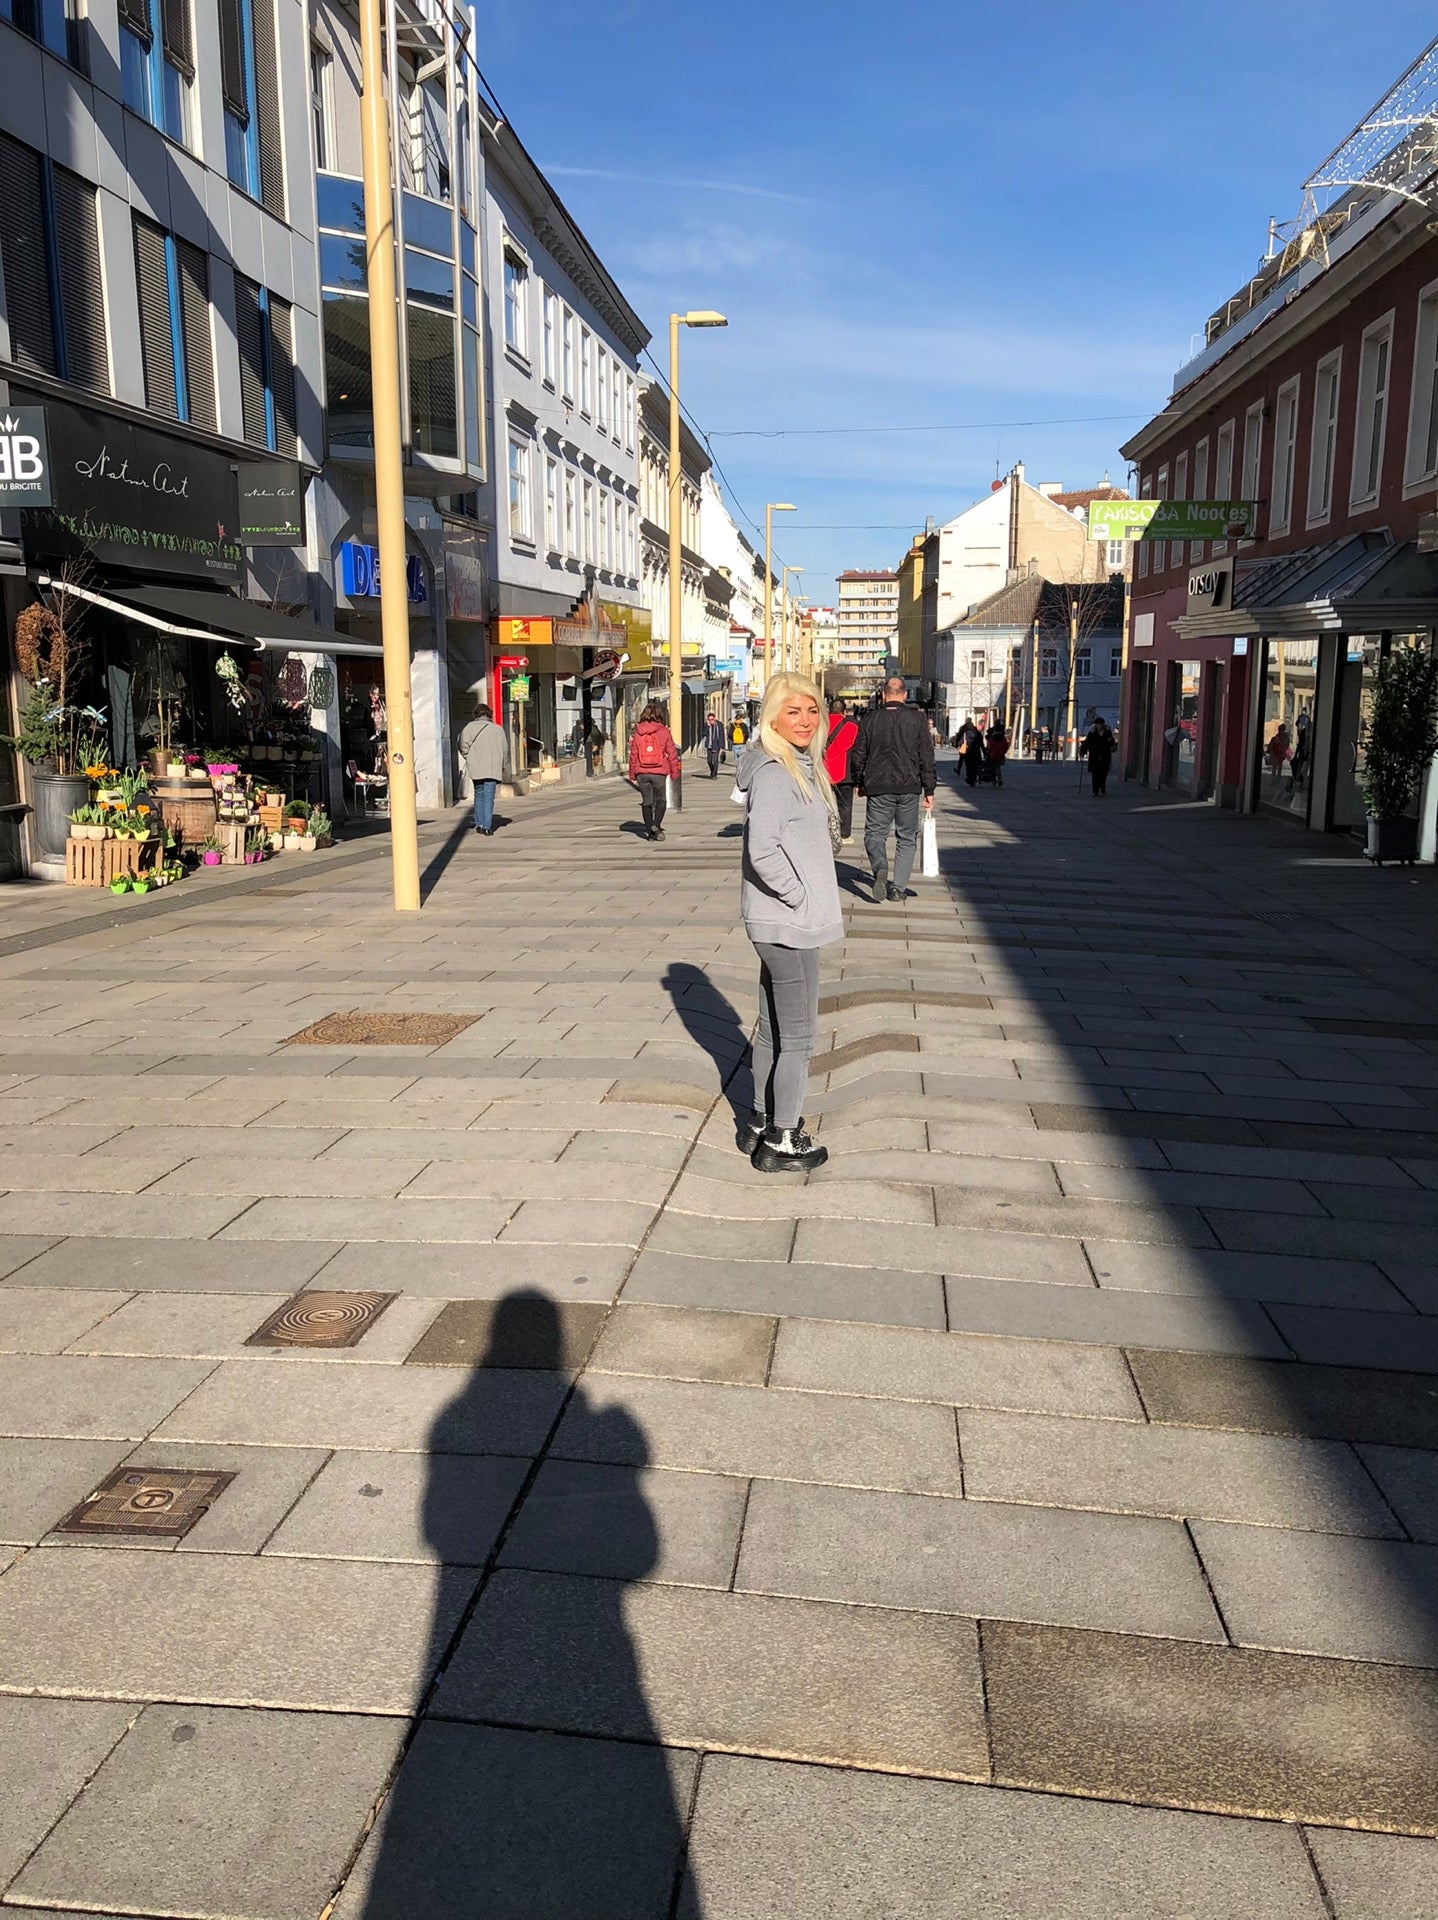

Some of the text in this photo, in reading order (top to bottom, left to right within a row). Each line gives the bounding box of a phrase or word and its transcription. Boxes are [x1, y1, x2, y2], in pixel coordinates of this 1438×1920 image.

[9, 482, 42, 491] BRIGITTE
[153, 462, 189, 498] Art
[1094, 503, 1249, 522] YAKISOBA Nooes
[342, 541, 428, 603] DEA
[1188, 571, 1220, 608] orsay
